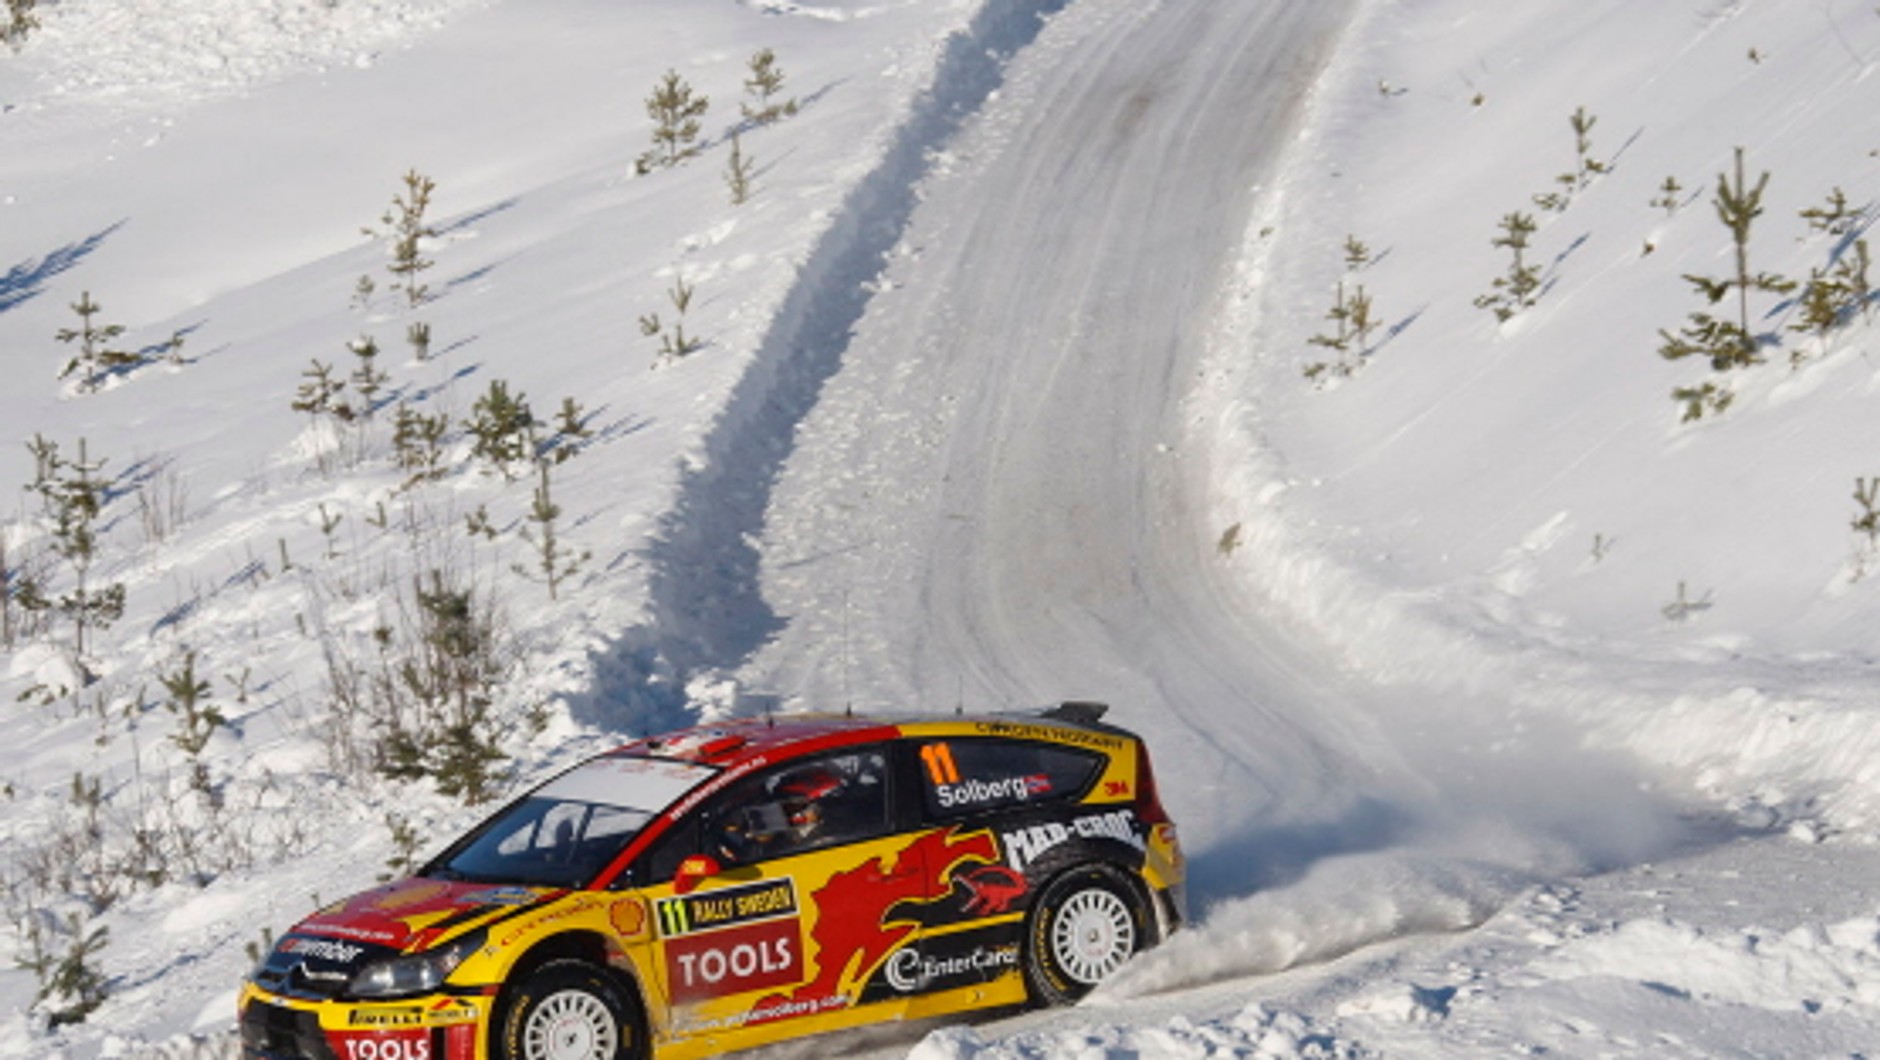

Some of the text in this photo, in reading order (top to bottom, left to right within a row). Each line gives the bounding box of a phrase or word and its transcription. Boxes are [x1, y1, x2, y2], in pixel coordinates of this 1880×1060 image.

[920, 742, 961, 786] 11
[937, 776, 1028, 808] Solberg
[1104, 781, 1130, 797] 3M
[1003, 810, 1146, 873] MAD-CROC
[663, 899, 689, 935] 11
[691, 885, 791, 923] RALLY SWEDEN
[677, 937, 792, 987] TOOLS
[348, 1007, 424, 1026] PIRELLI
[345, 1039, 430, 1060] TOOLS
